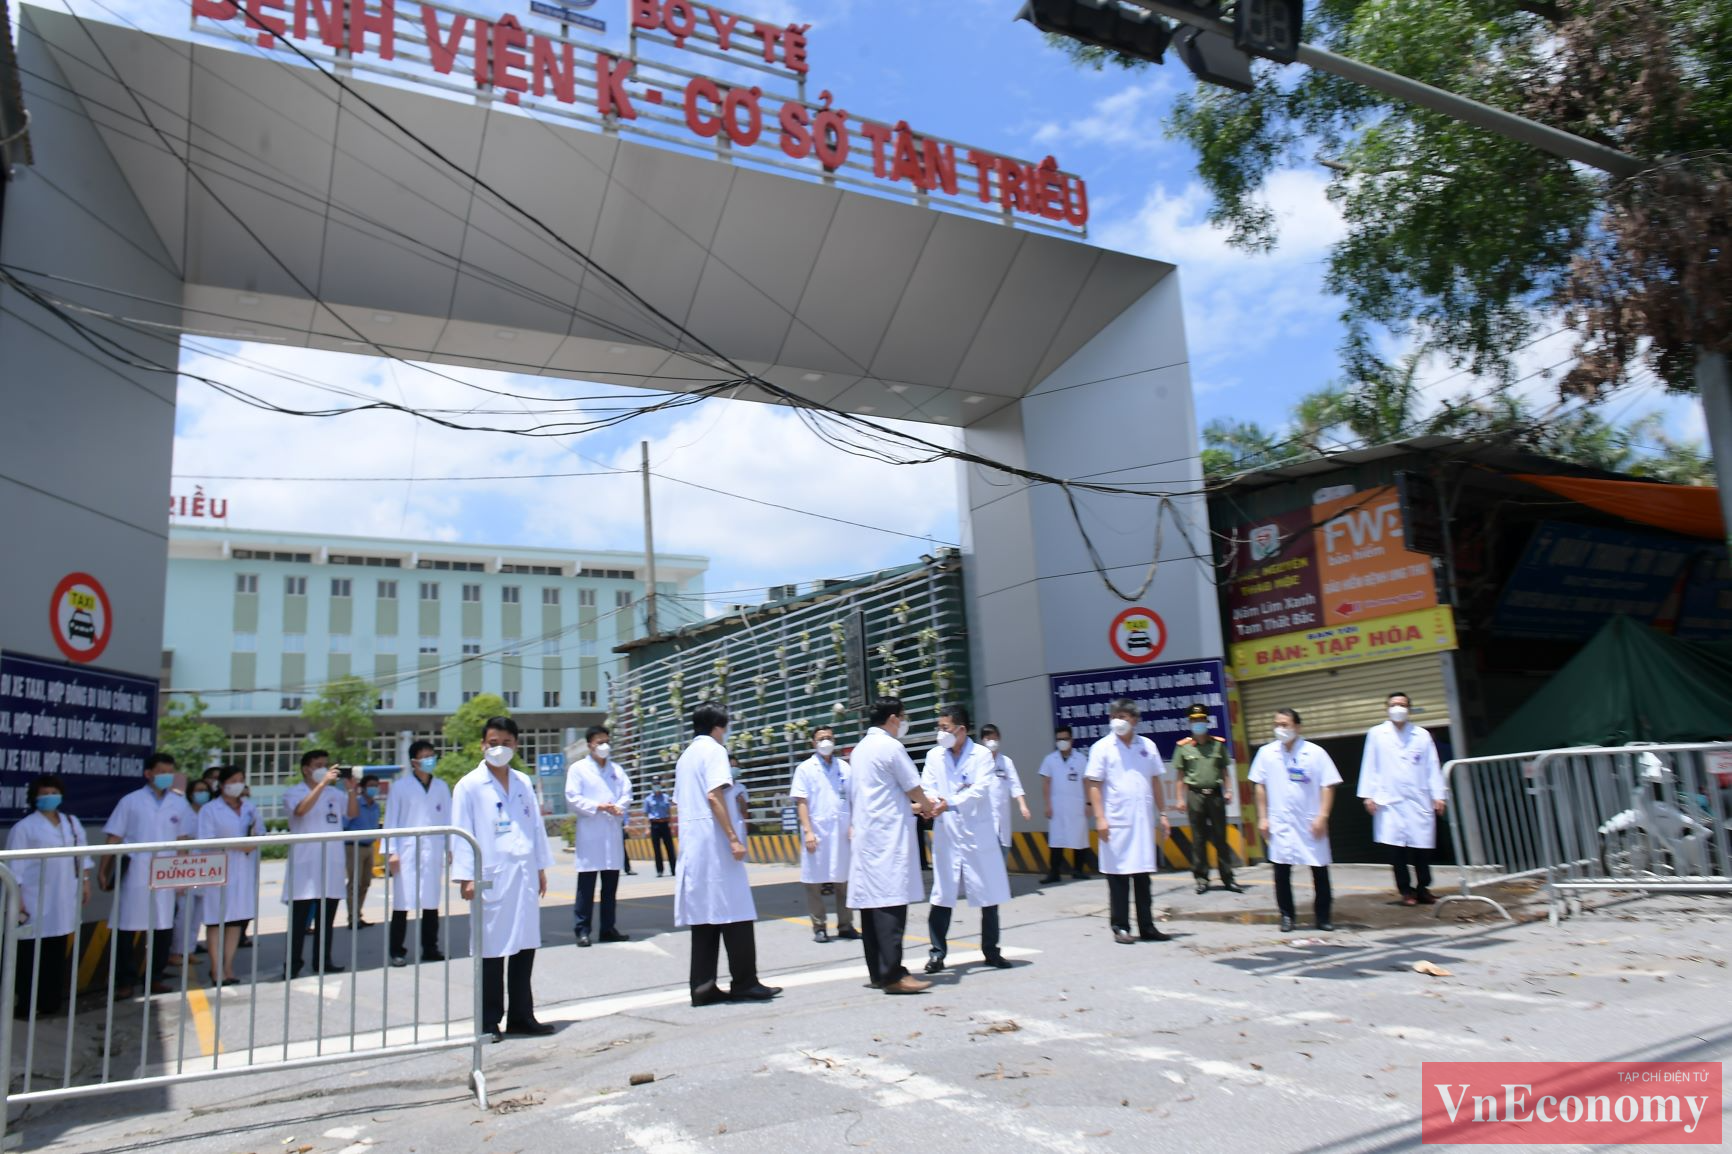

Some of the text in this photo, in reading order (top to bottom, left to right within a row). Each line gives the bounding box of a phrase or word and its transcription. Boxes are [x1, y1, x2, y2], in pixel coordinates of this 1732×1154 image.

[708, 8, 738, 51] Y
[754, 23, 811, 73] TẾ
[419, 6, 575, 105] VIỆN
[595, 52, 637, 119] K
[683, 76, 762, 146] CƠ
[779, 89, 849, 169] SỞ
[861, 119, 959, 195] TÂN
[69, 591, 96, 610] TAXI
[1235, 622, 1262, 637] Tam
[1314, 634, 1360, 656] TẠP
[1368, 624, 1423, 647] HÓA
[104, 723, 111, 743] 2
[199, 866, 222, 878] LẠI
